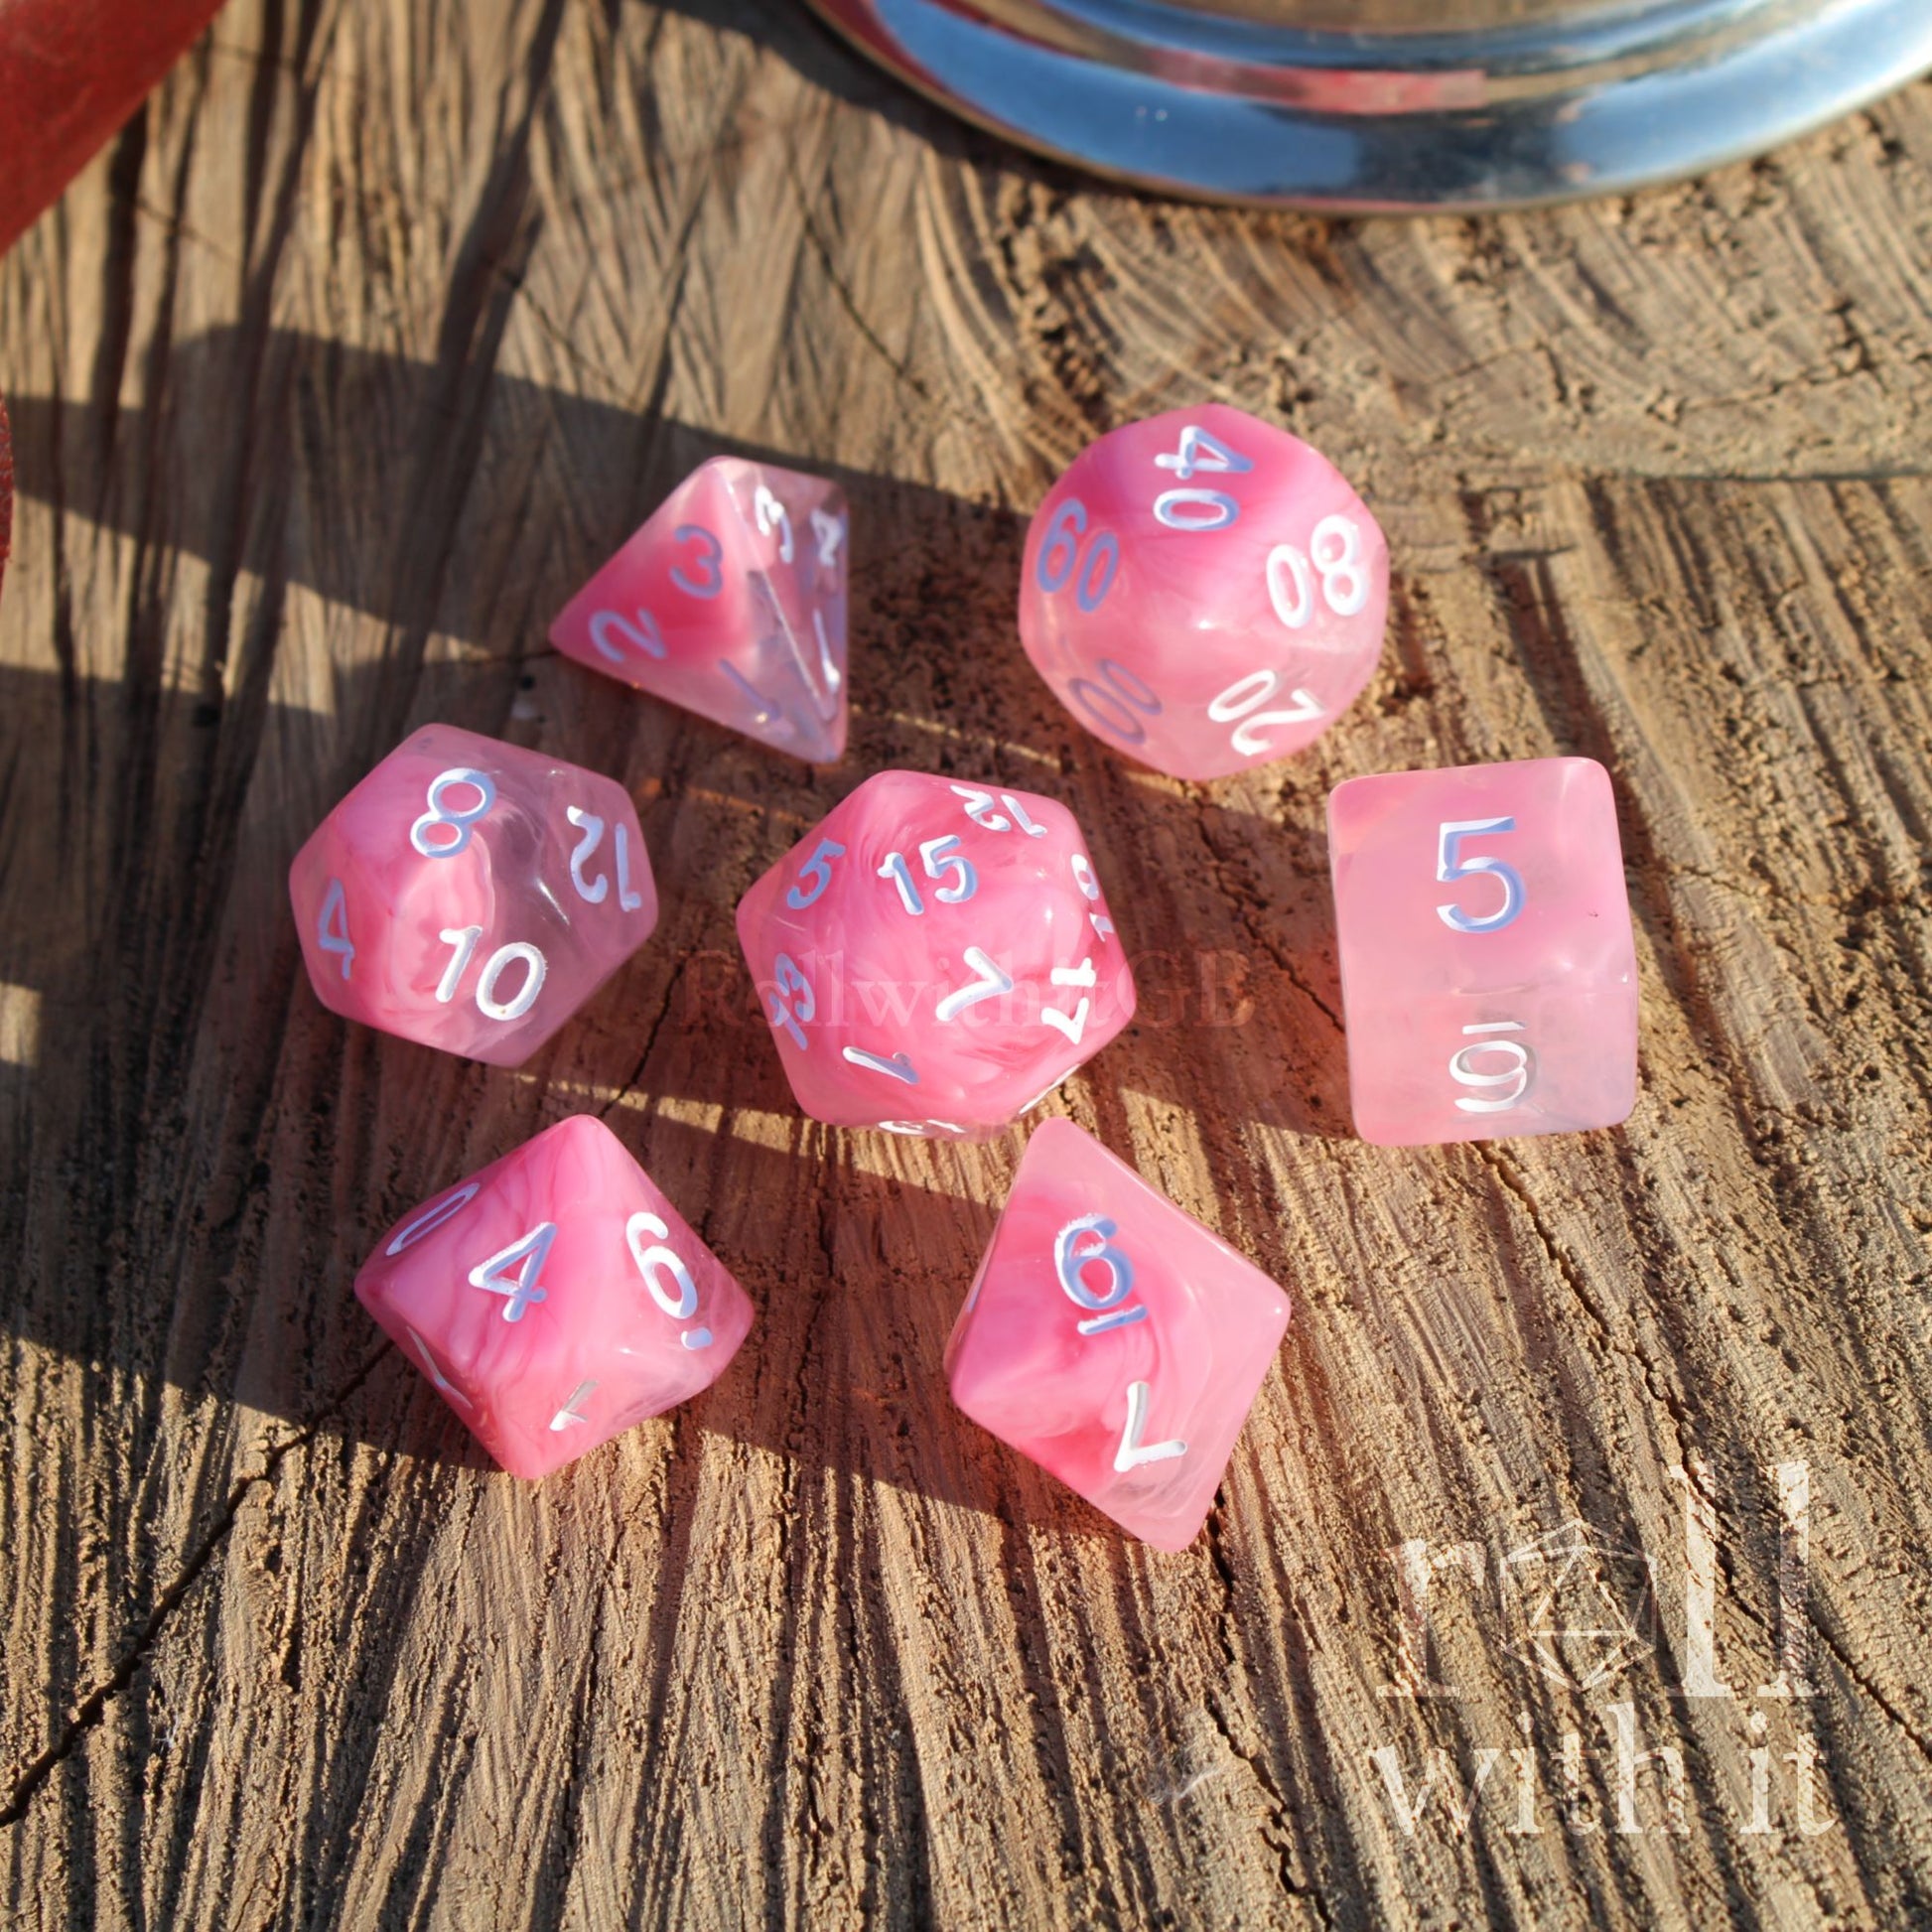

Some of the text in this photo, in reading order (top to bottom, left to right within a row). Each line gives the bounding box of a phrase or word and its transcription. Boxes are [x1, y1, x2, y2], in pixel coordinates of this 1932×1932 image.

[1154, 426, 1254, 530] 40
[670, 525, 723, 600] 3
[1035, 498, 1119, 613] 60
[1266, 514, 1368, 628] 80
[589, 609, 667, 664] 2
[1068, 658, 1164, 745] 00
[1207, 669, 1326, 757] 20
[410, 767, 496, 859] 8
[950, 784, 1048, 838] 12
[567, 805, 641, 912] 12
[786, 837, 846, 909] 5
[877, 834, 979, 915] 15
[1436, 816, 1527, 934] 5
[318, 878, 355, 980] 4
[435, 925, 548, 1022] 10
[935, 946, 1014, 1022] 7
[386, 1182, 481, 1256] 0
[468, 1221, 558, 1323] 4
[1113, 1381, 1187, 1472] 7
